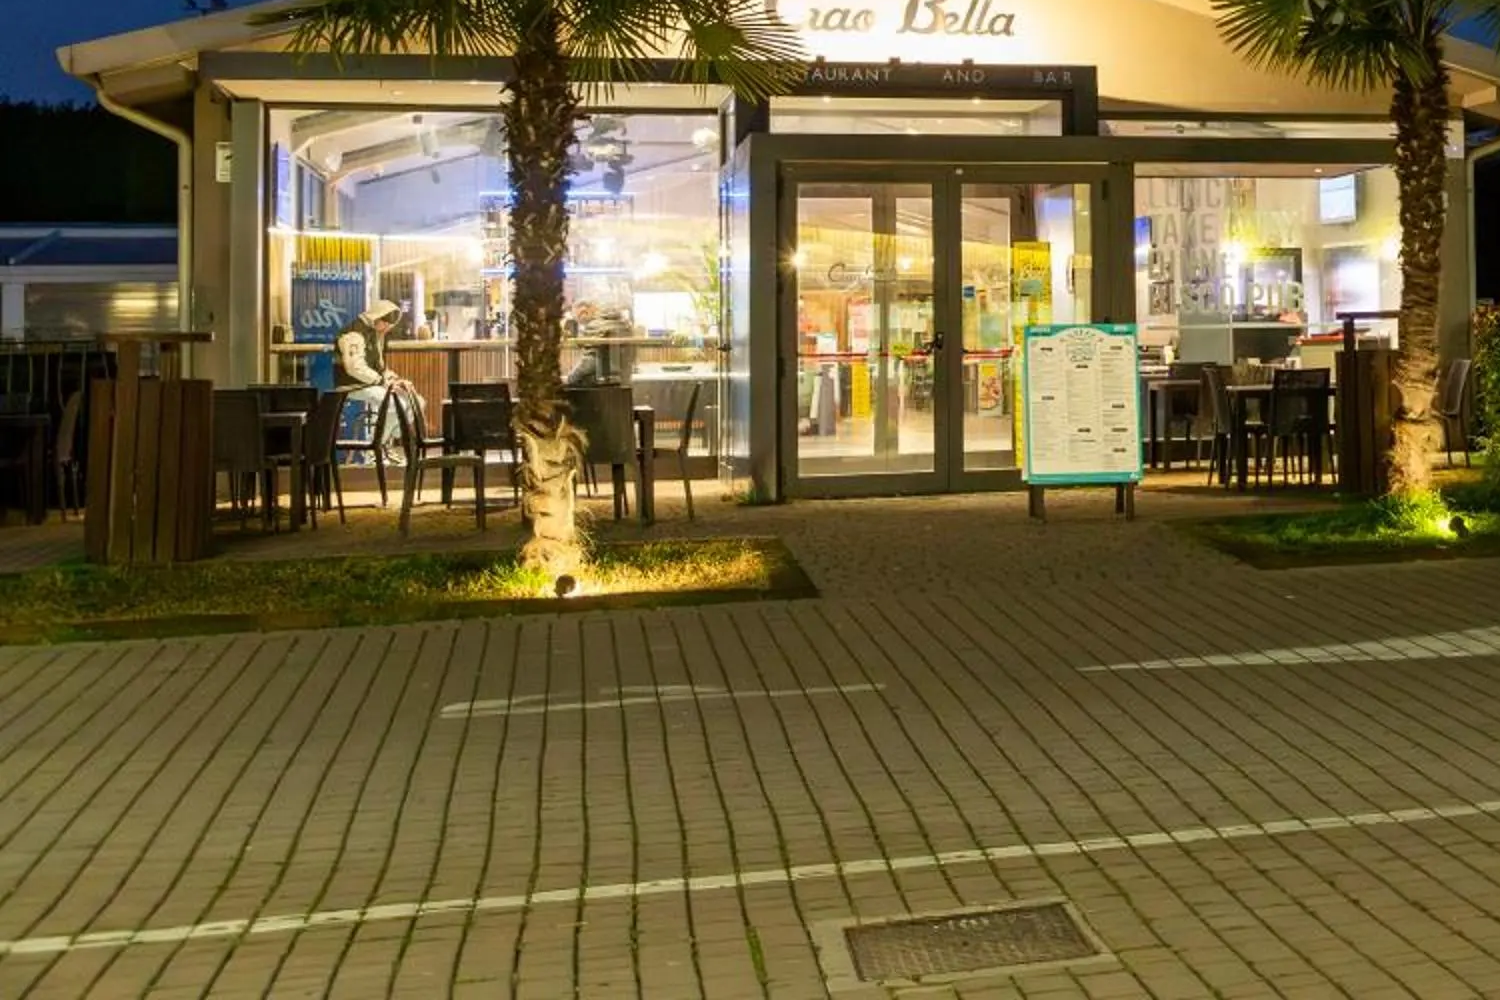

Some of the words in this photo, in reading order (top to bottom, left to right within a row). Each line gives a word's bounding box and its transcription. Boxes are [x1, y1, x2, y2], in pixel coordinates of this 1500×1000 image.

[767, 67, 892, 83] TAURANT
[943, 69, 986, 85] AND
[1033, 71, 1074, 84] BAR
[1151, 212, 1218, 246] TAKE
[1245, 279, 1305, 314] PUB
